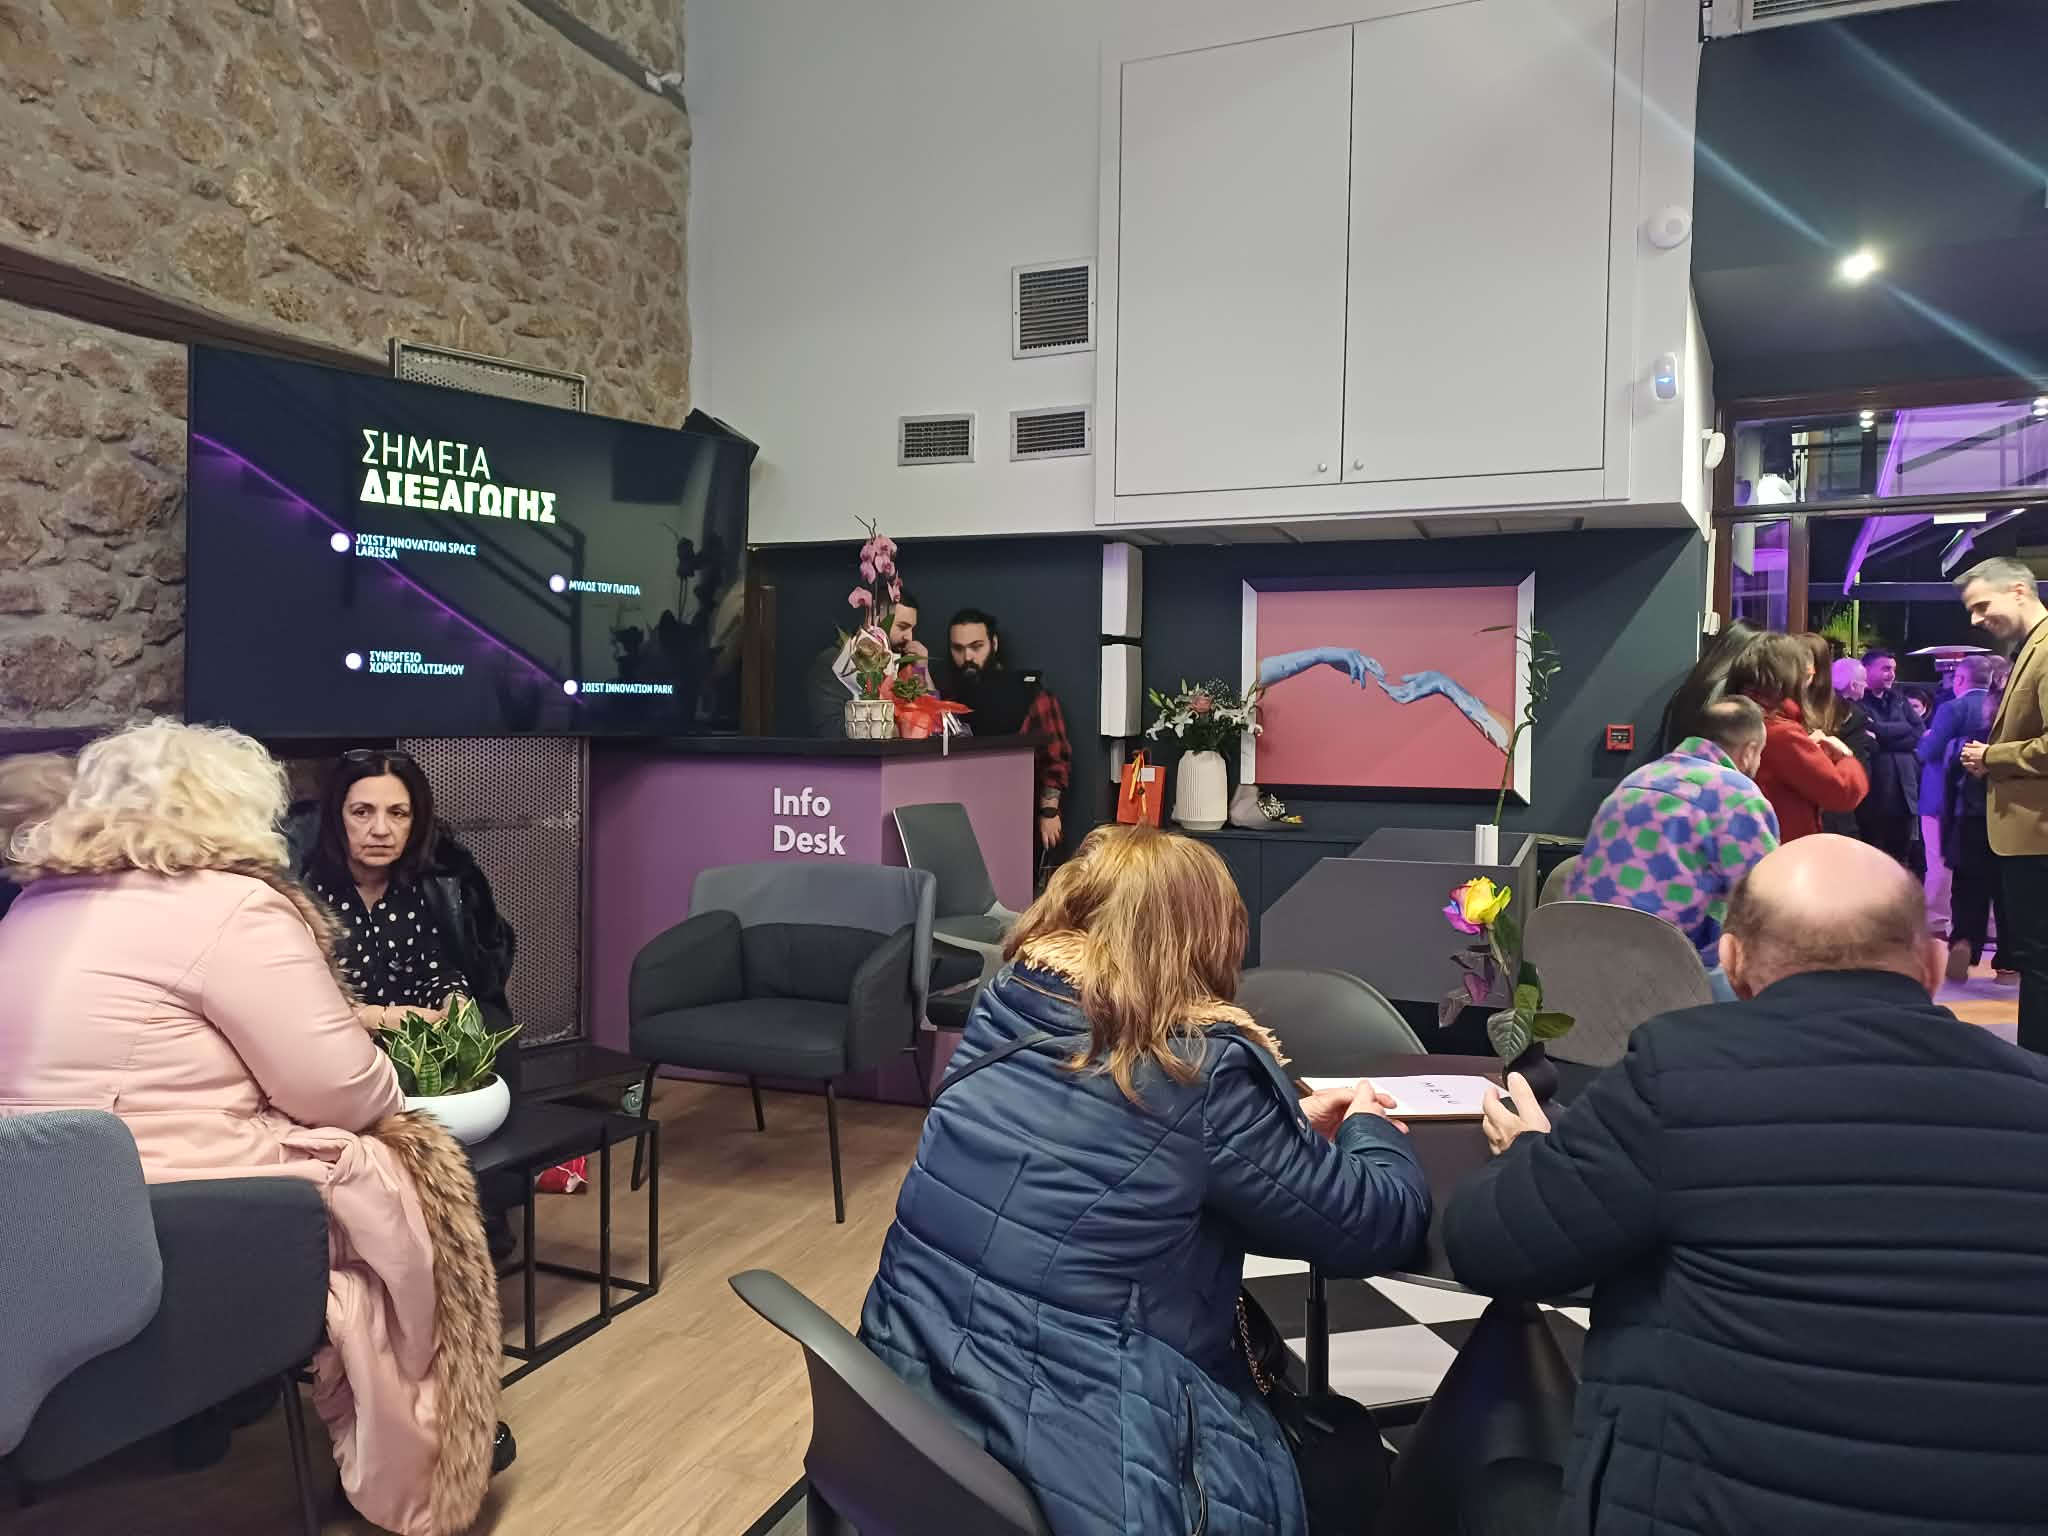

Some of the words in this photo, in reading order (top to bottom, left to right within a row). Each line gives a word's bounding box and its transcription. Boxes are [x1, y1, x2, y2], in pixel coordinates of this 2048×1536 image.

[361, 428, 491, 480] ΣΗΜΕΙΑ
[359, 468, 556, 524] ΔΙΕΞΑΓΩΓΗΣ
[355, 533, 385, 547] JOIST
[386, 535, 448, 554] INNOVATION
[448, 542, 477, 556] SPACE
[355, 546, 399, 560] LARISSA
[568, 580, 597, 593] ΜΥΛΟΣ
[597, 582, 613, 593] ΤΟΥ
[613, 584, 641, 596] ΠΑΠΠΑ
[369, 650, 422, 663] ΣΥΝΕΡΓΕΙΟ
[369, 662, 403, 674] ΧΩΡΟΣ
[403, 663, 465, 676] ΠΟΛΙΤΙΣΜΟΥ
[581, 682, 605, 693] JOIST
[605, 683, 653, 694] INNOVATION
[653, 684, 673, 695] PARK
[773, 786, 831, 817] Info
[773, 824, 847, 856] Desk
